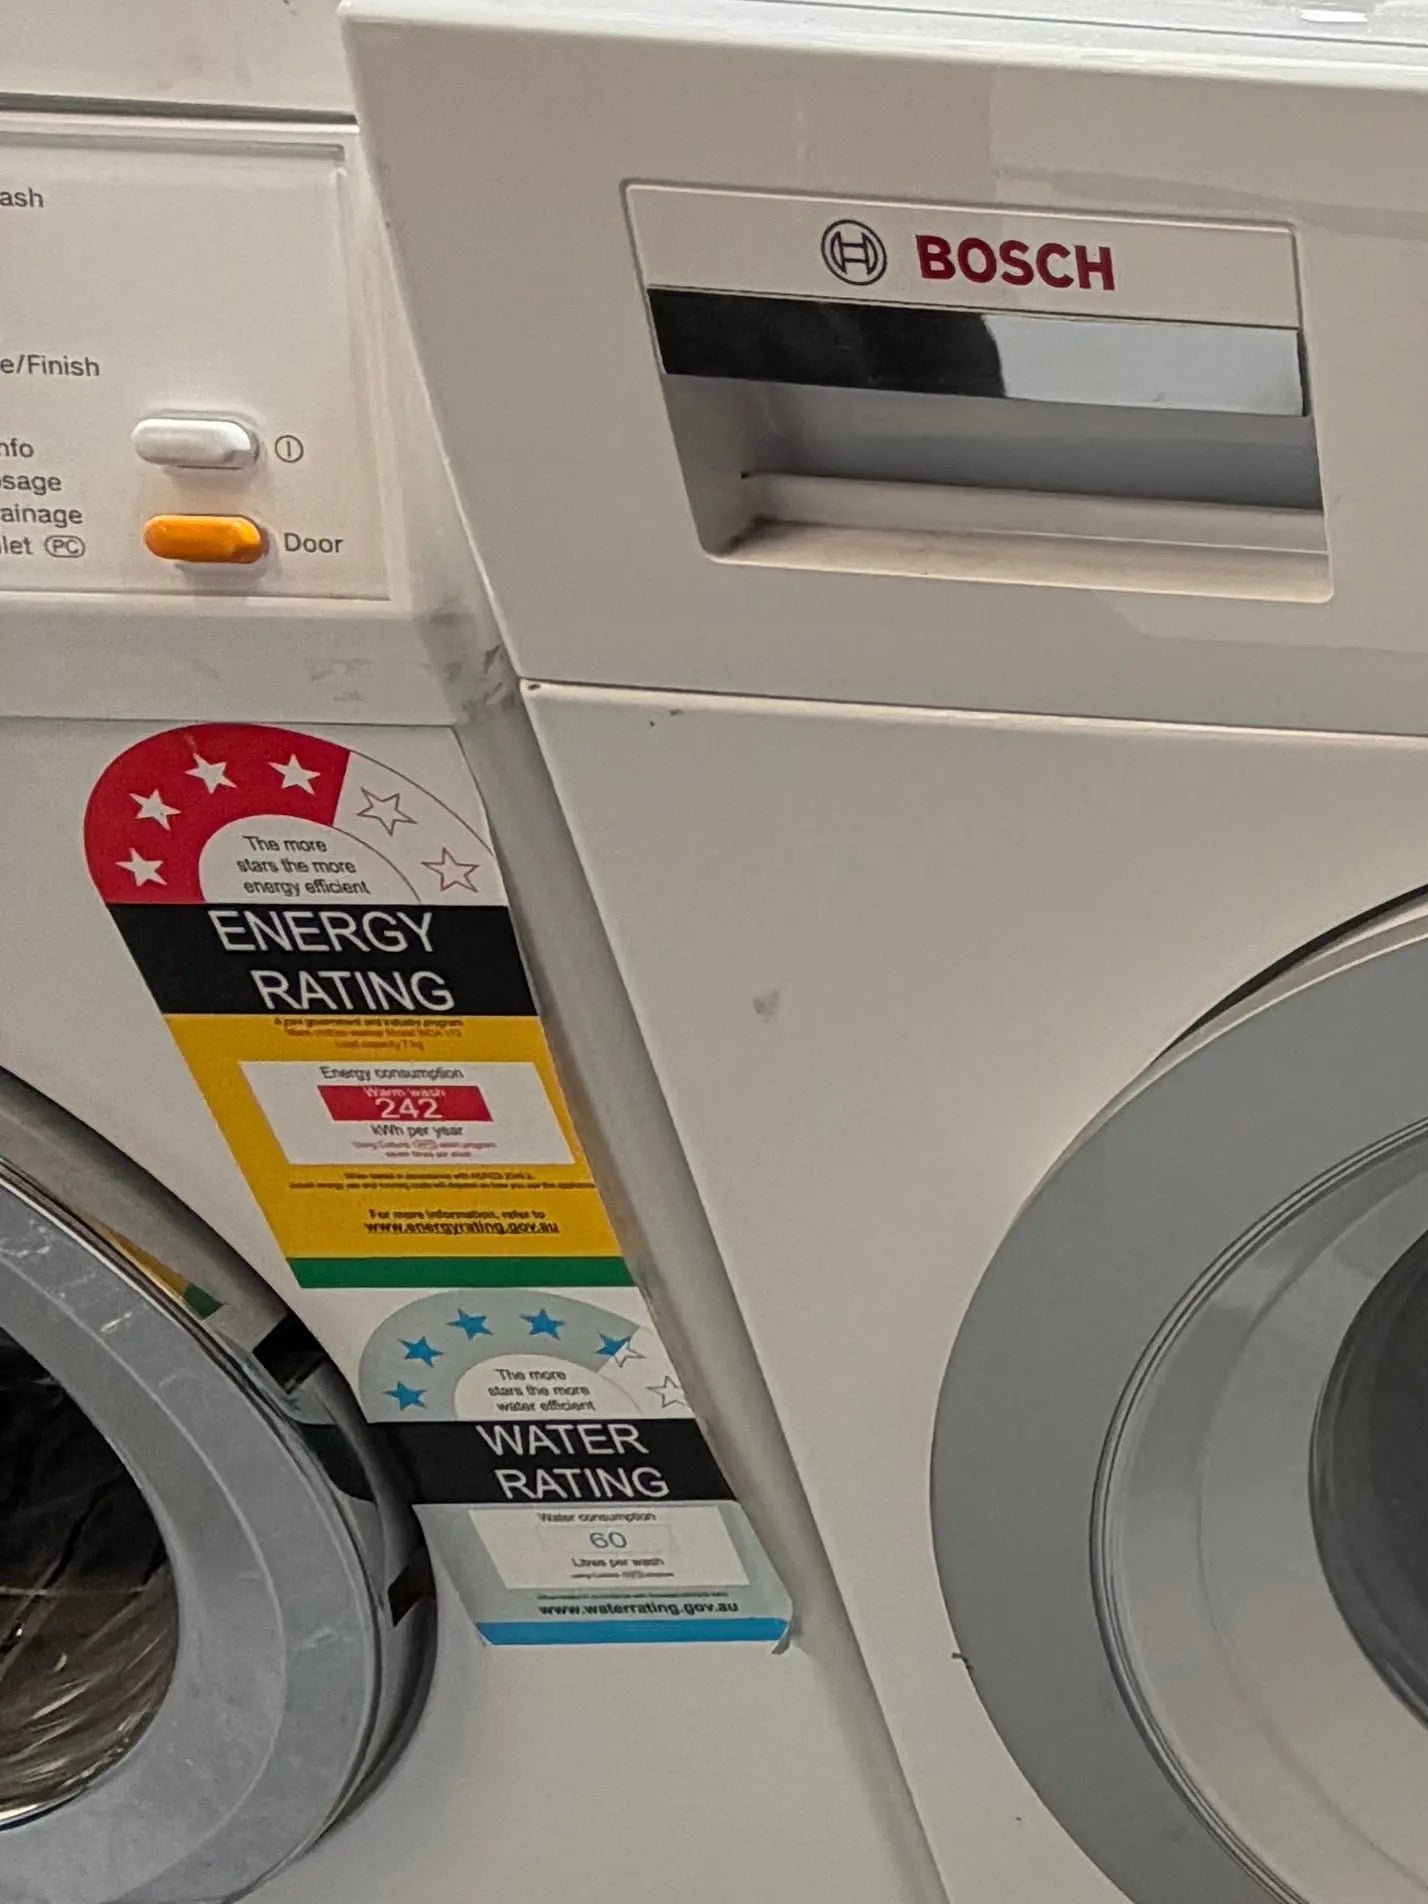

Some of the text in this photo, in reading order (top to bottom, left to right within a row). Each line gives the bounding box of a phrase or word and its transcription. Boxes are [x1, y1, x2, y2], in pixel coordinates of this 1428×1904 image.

[915, 234, 1115, 291] BOSCH
[285, 532, 344, 553] Door
[243, 835, 327, 852] The more
[237, 859, 356, 873] stars the more
[243, 879, 371, 897] energy efficient
[207, 910, 433, 952] ENERGY
[250, 969, 455, 1011] RATING
[319, 1066, 464, 1081] Energy consumption
[375, 1098, 442, 1118] 242
[371, 1125, 464, 1139] kWh per year
[364, 1221, 560, 1235] www.energyrating.gov.au
[495, 1369, 566, 1381] The more
[488, 1385, 590, 1397] stars the more
[496, 1400, 596, 1412] water efficient
[476, 1423, 649, 1456] WATER
[494, 1467, 670, 1500] RATING
[538, 1512, 657, 1524] Water consumption
[590, 1531, 627, 1549] 60
[538, 1601, 739, 1616] www.waterrating.gov.au
